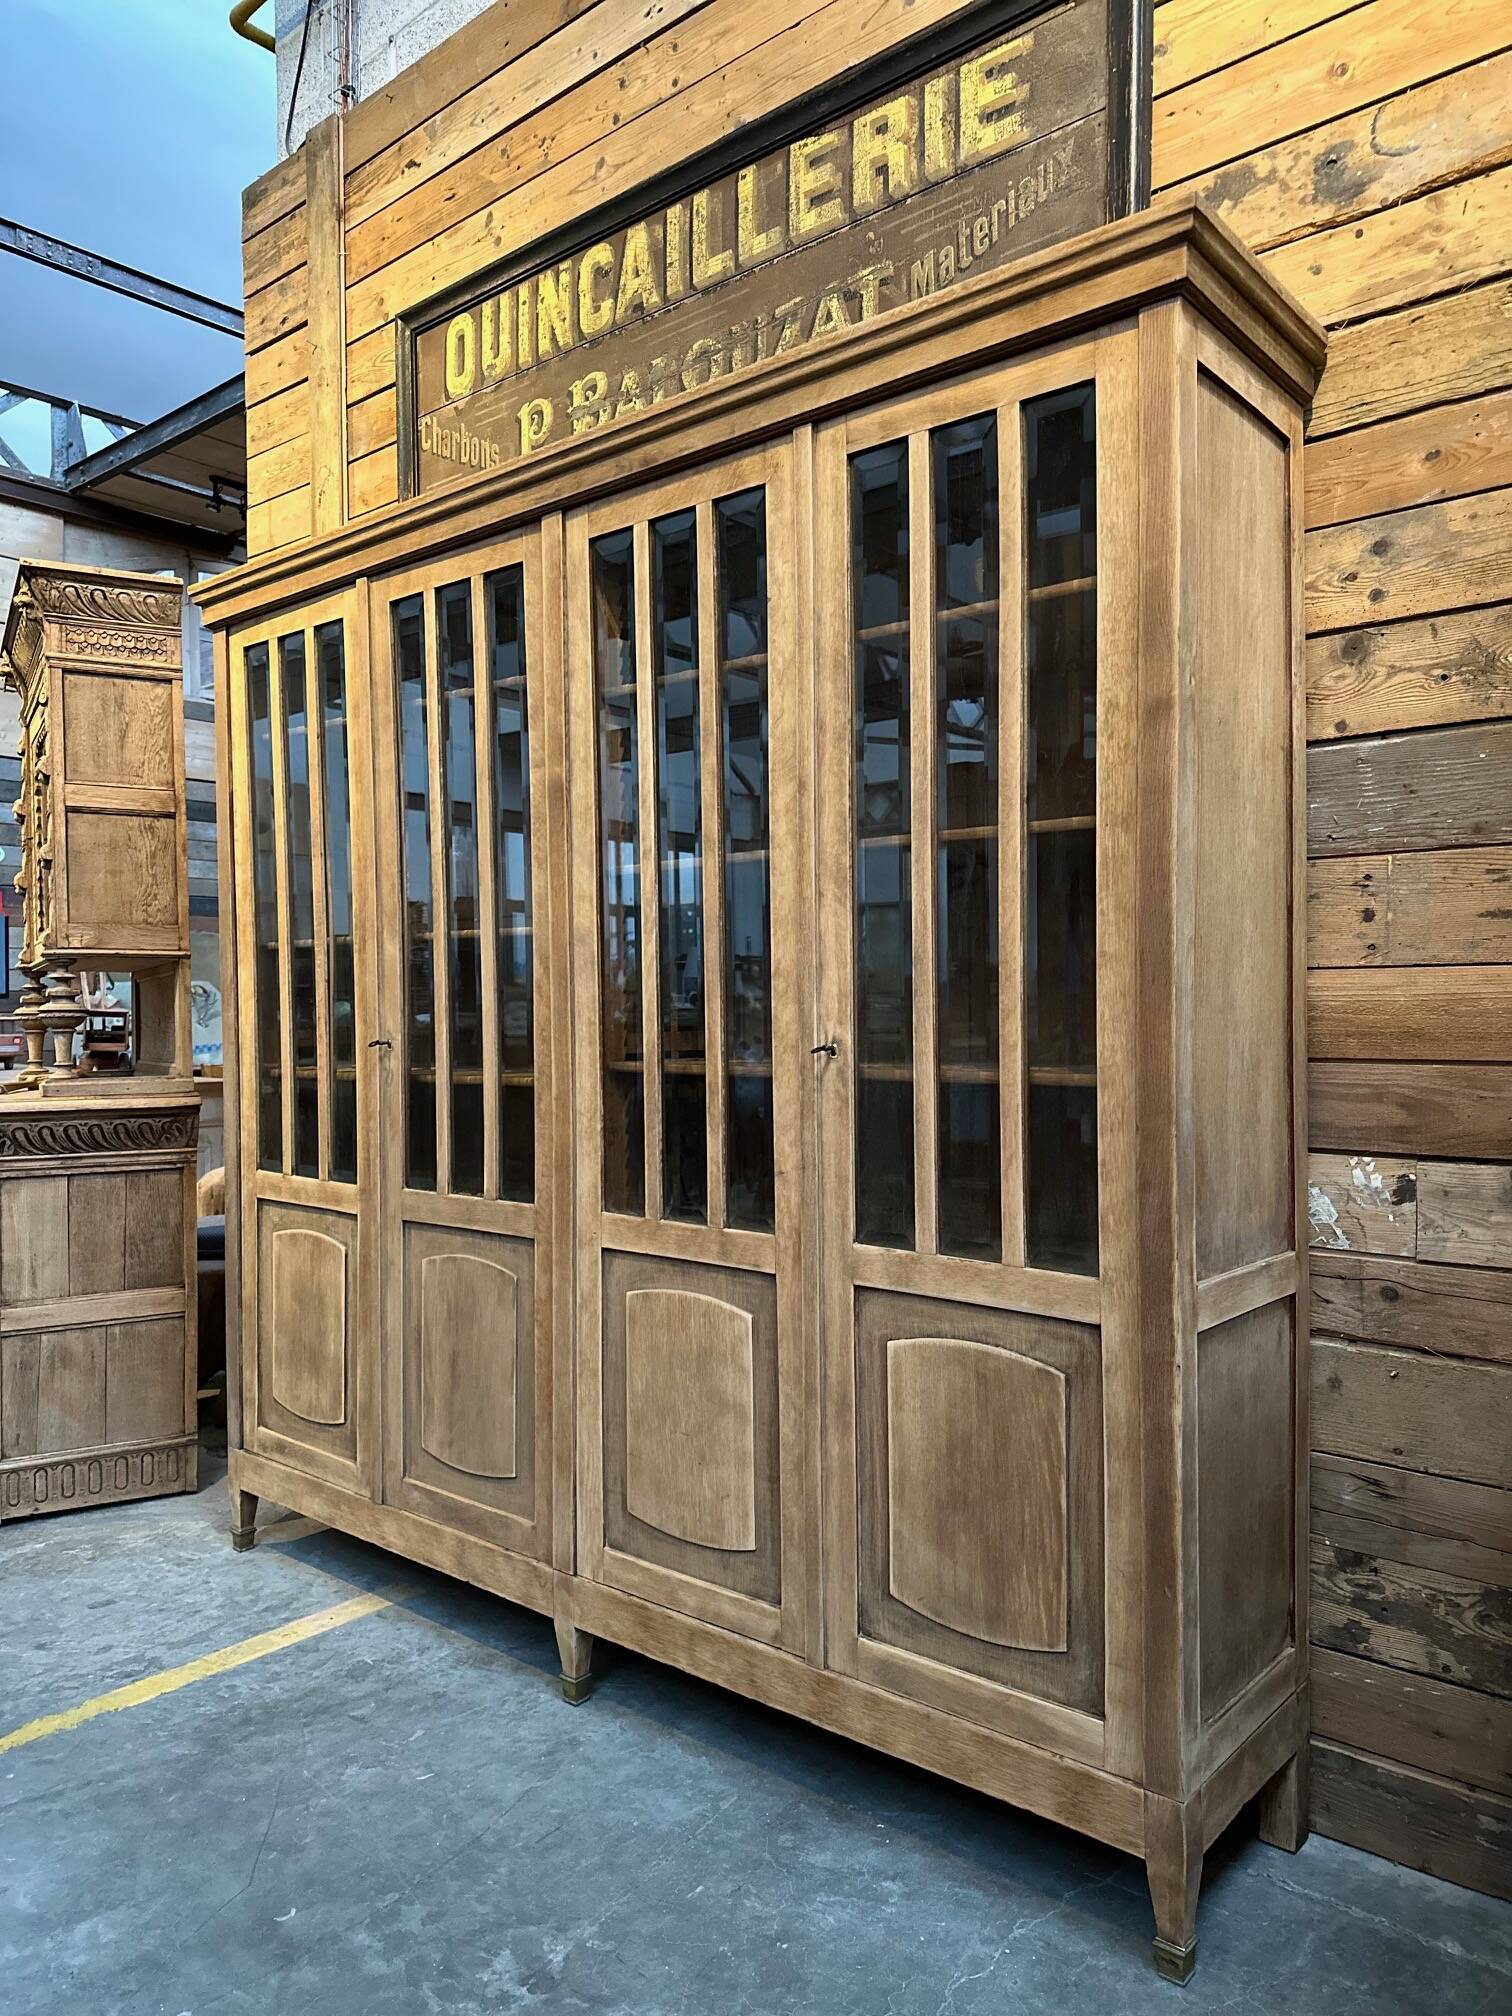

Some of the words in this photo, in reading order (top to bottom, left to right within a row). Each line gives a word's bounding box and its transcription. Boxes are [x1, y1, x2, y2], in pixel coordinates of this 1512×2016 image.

[444, 32, 1035, 403] QUINCAILLERIE
[421, 415, 500, 469] Charbons
[517, 397, 554, 456] P
